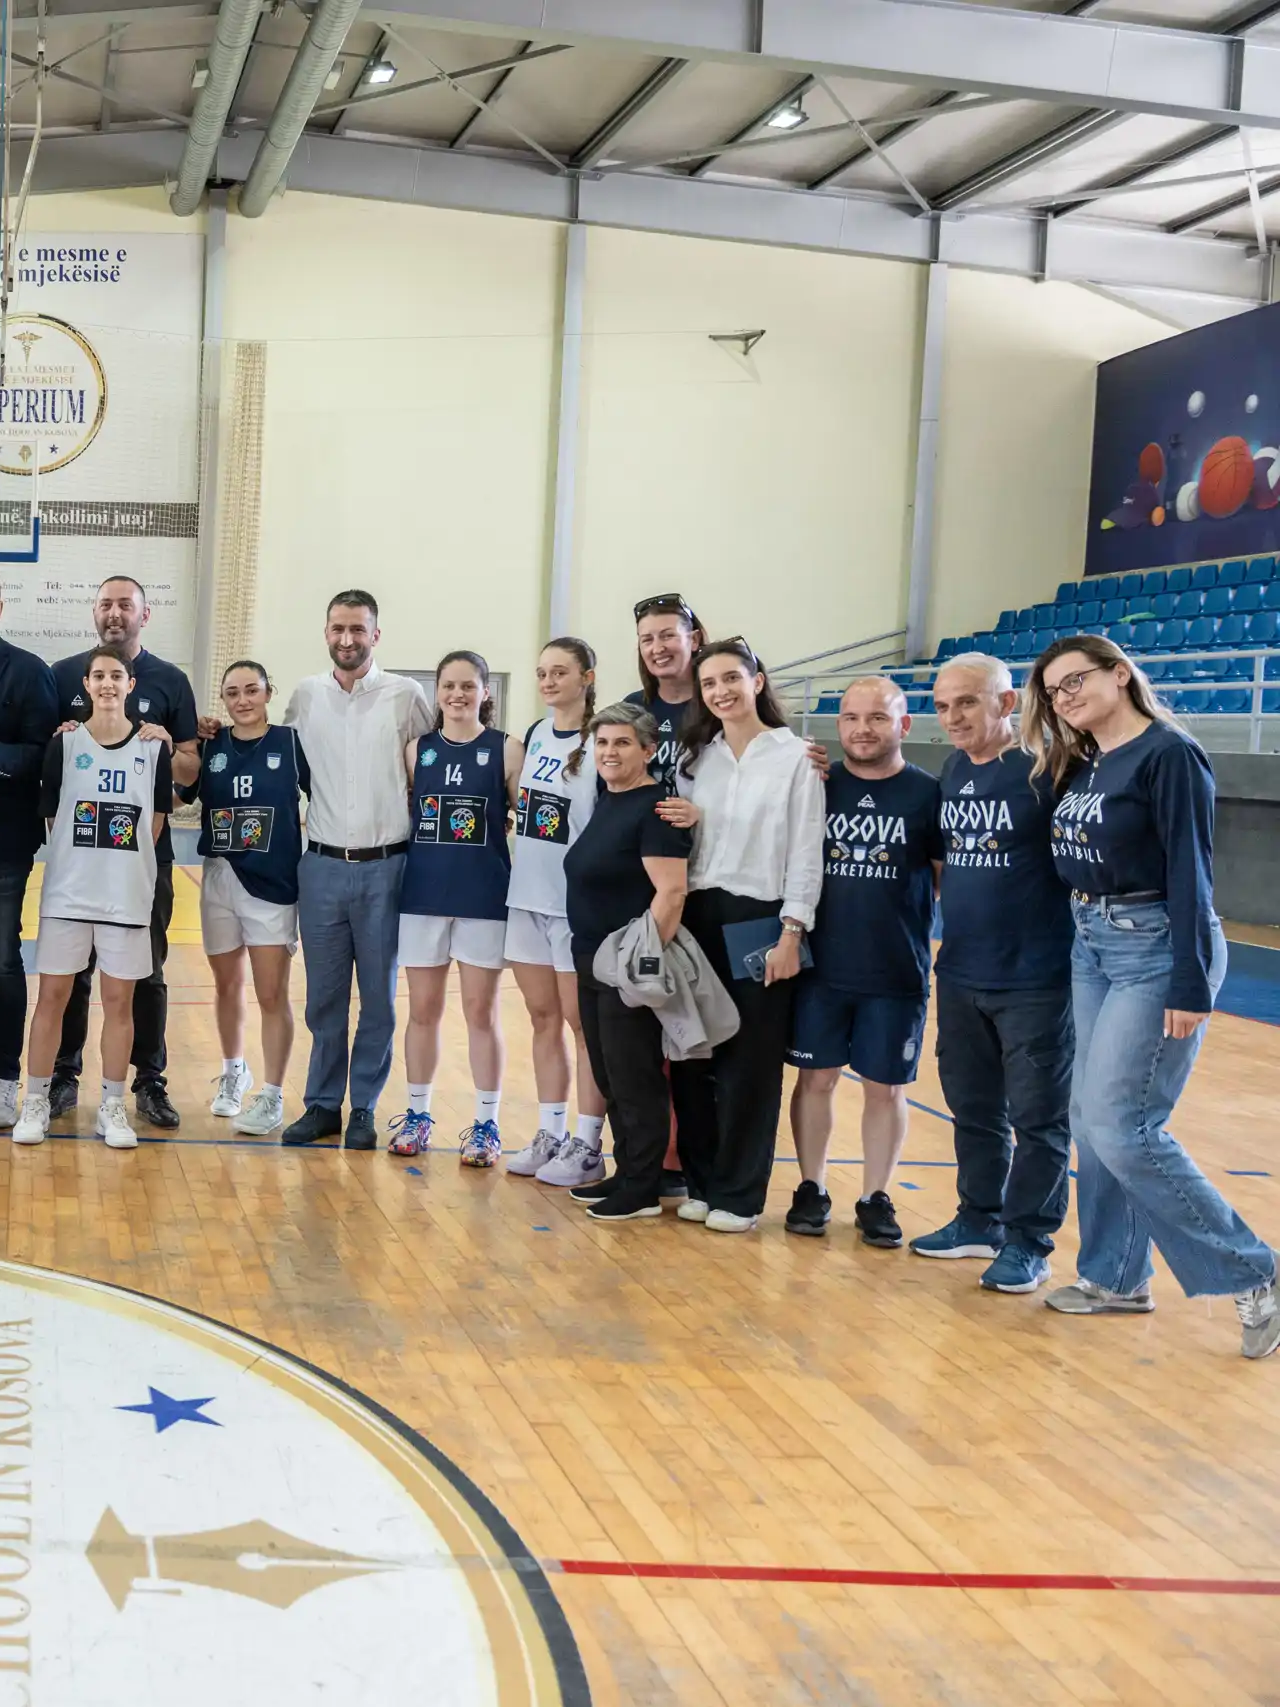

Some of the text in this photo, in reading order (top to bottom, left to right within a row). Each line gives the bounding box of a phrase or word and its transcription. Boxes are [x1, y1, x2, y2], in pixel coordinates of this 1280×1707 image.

[18, 248, 29, 262] e
[36, 248, 110, 262] mesme
[116, 248, 127, 262] e
[18, 264, 121, 287] mjekësisë
[38, 509, 108, 525] hkollimi
[114, 510, 153, 529] juaj!
[444, 763, 463, 786] 14
[531, 755, 562, 783] 22
[97, 768, 126, 794] 30
[232, 775, 253, 799] 18
[419, 822, 435, 830] FIBA
[940, 800, 1014, 830] KOSOVA
[76, 827, 93, 836] FIBA
[825, 813, 907, 845] KOSOVA
[825, 862, 899, 879] ASKETBALL
[947, 852, 1010, 867] SKETBALL
